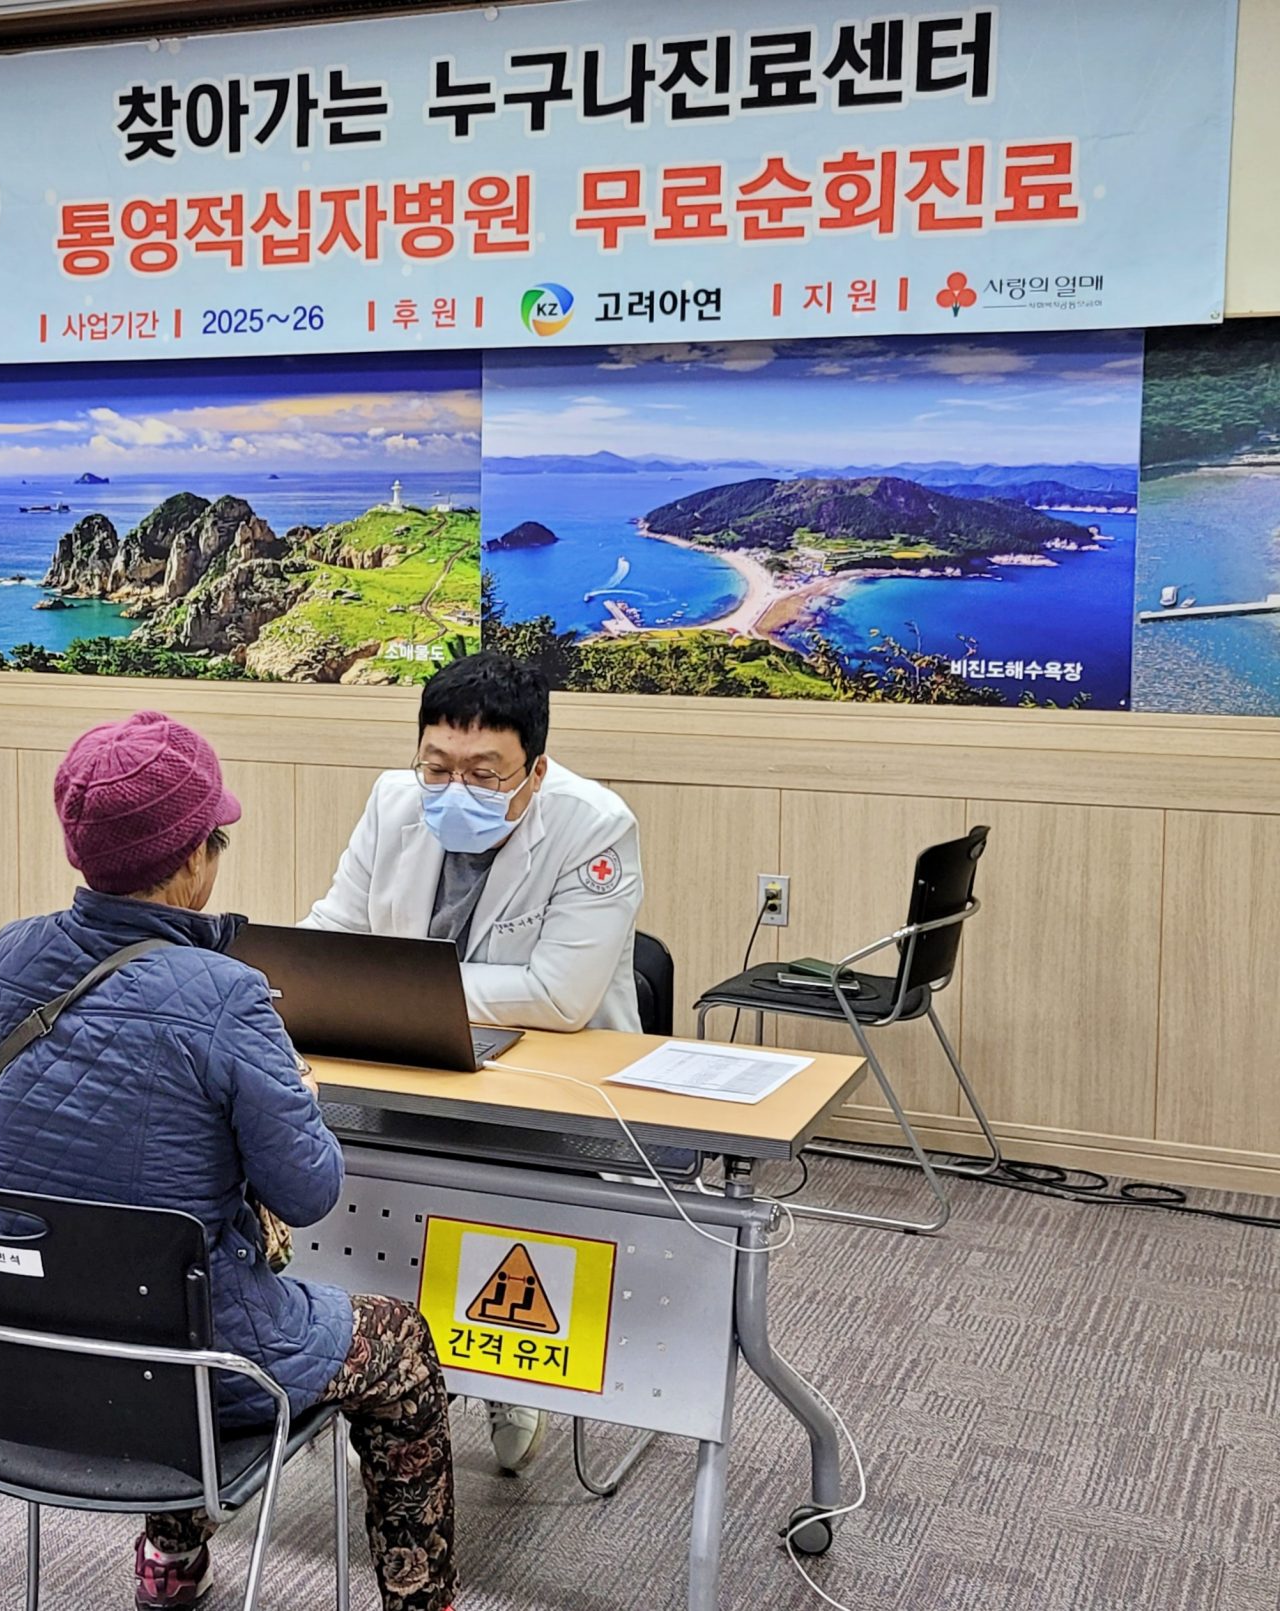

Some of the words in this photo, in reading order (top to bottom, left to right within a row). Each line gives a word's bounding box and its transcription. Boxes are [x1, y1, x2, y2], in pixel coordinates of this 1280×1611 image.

[117, 71, 389, 161] 찾아가는
[427, 11, 993, 137] 누구나진료센터
[56, 174, 532, 276] 통영적십자병원
[574, 142, 1080, 250] 무료순회진료
[594, 287, 721, 323] 고려아연
[983, 276, 1049, 300] 사랑의
[1055, 275, 1103, 298] 열매
[62, 310, 159, 341] 사업기간
[202, 305, 324, 334] 2025~26
[536, 303, 558, 317] KZ
[384, 643, 445, 661] 소매물도
[950, 659, 1083, 682] 비진도해수욕장
[448, 1328, 504, 1365] 간격
[513, 1339, 570, 1377] 유지
